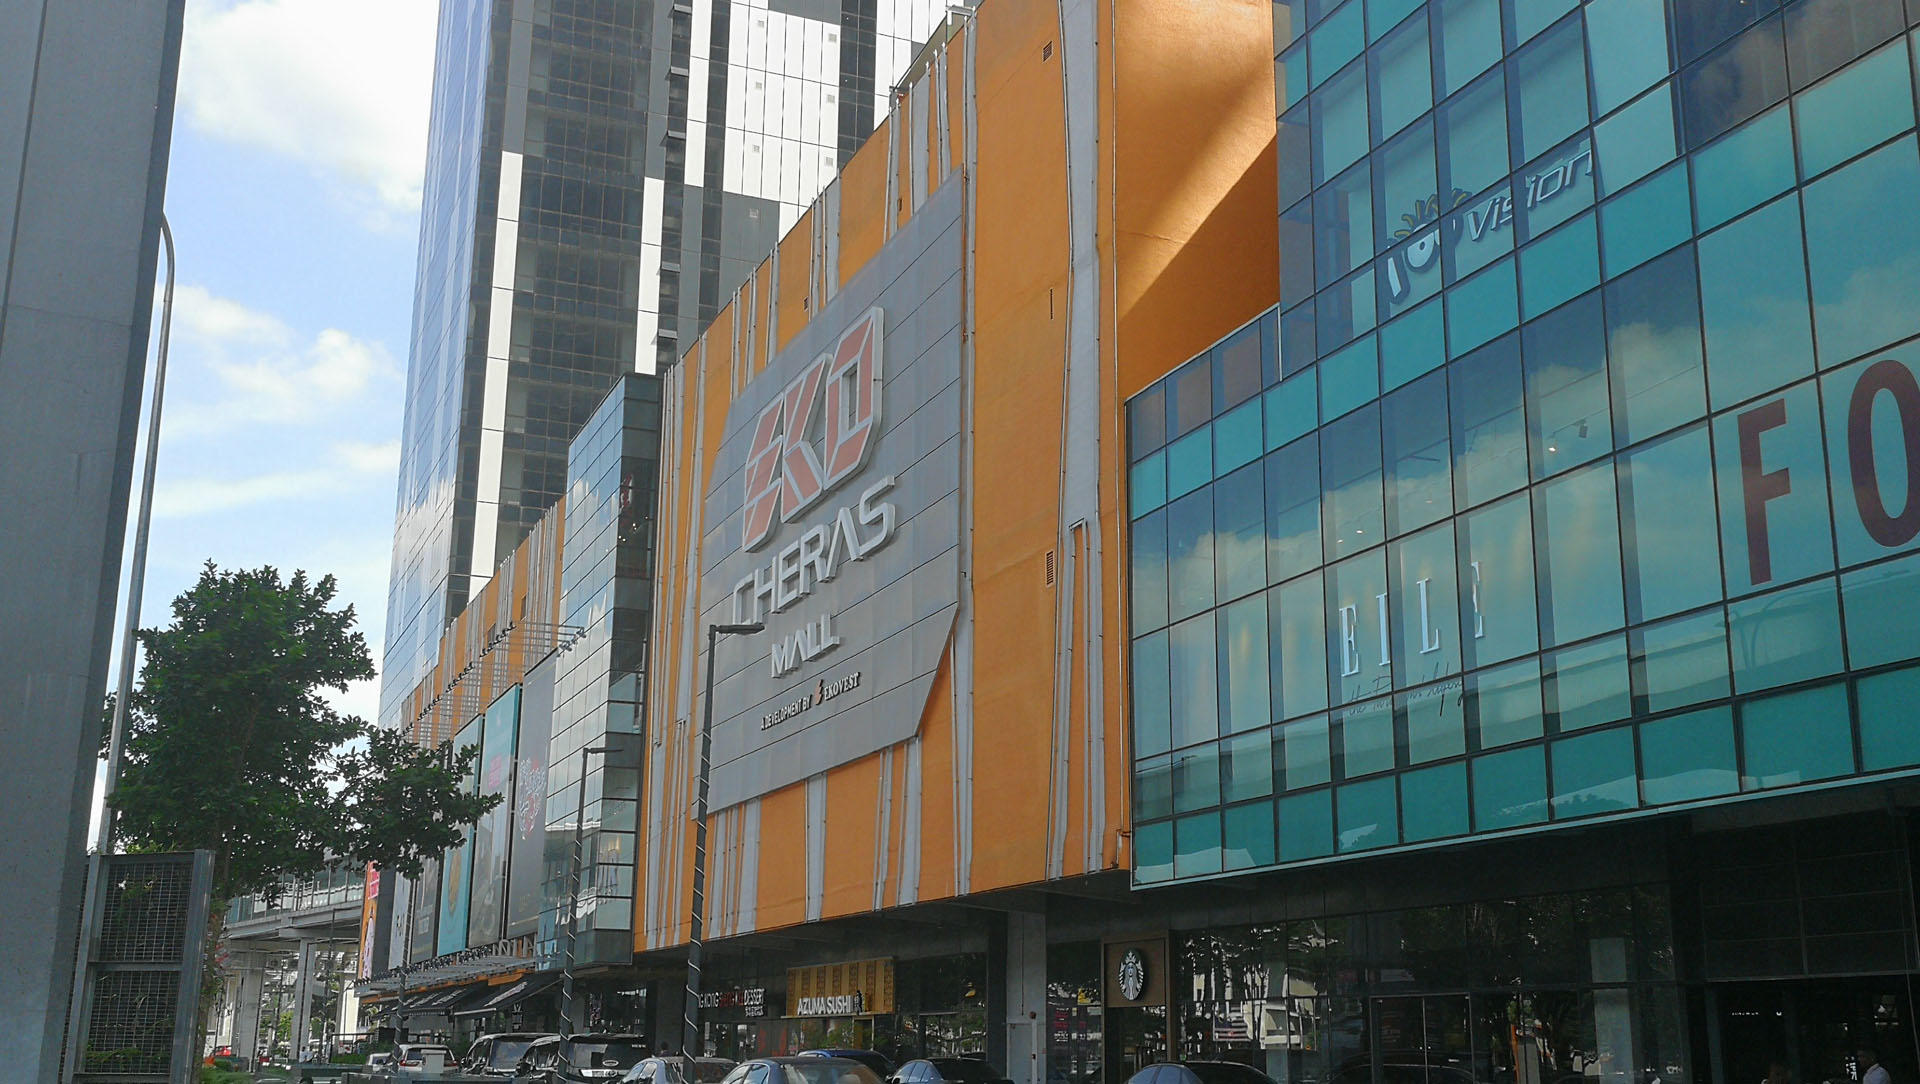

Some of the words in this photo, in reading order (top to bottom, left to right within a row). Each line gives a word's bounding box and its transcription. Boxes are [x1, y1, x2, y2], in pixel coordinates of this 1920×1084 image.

[1466, 148, 1595, 243] Vision
[742, 306, 884, 553] EKO
[733, 475, 896, 626] CHERAS
[771, 612, 840, 679] MALL
[765, 698, 804, 729] DEVELOPMENT
[803, 694, 813, 712] BY
[823, 672, 862, 701] EKOVEST
[797, 996, 827, 1016] AZUMA
[826, 994, 852, 1015] SUSHI
